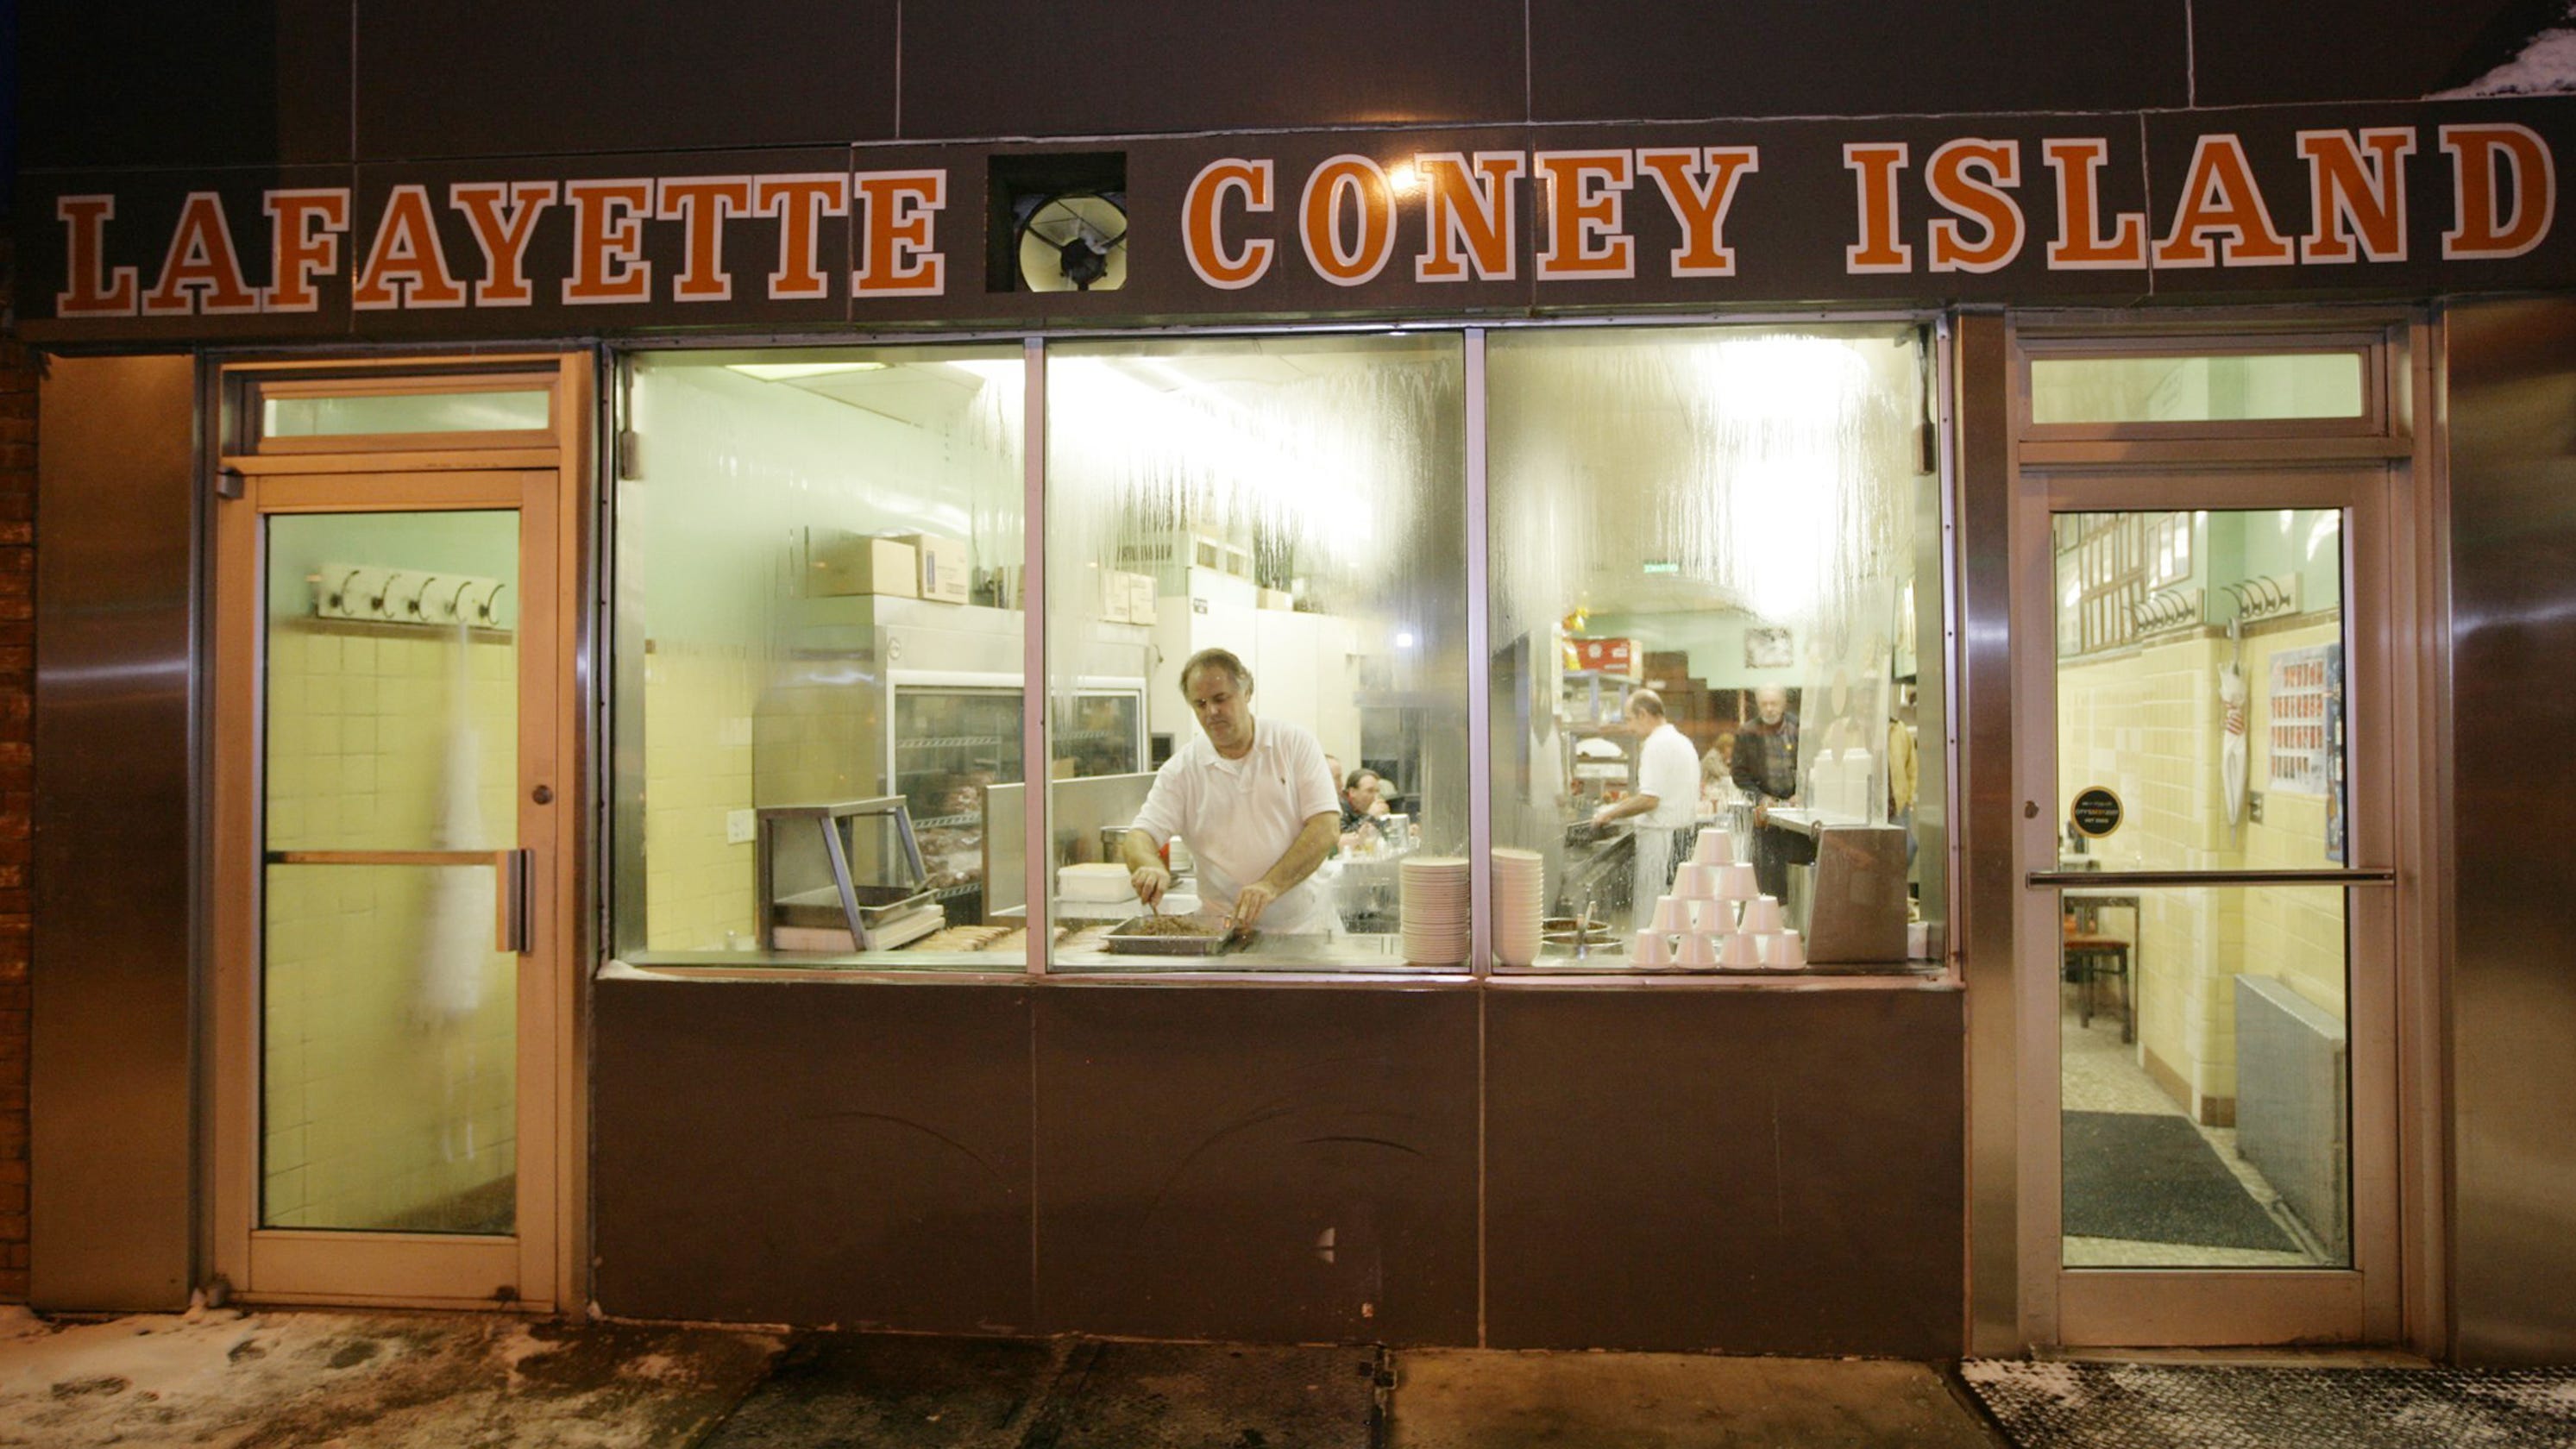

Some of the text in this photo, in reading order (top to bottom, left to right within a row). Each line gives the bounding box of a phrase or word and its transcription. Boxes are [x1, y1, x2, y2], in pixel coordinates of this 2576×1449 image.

[57, 123, 2557, 318] LAFAYETTE CONEY ISLAND
